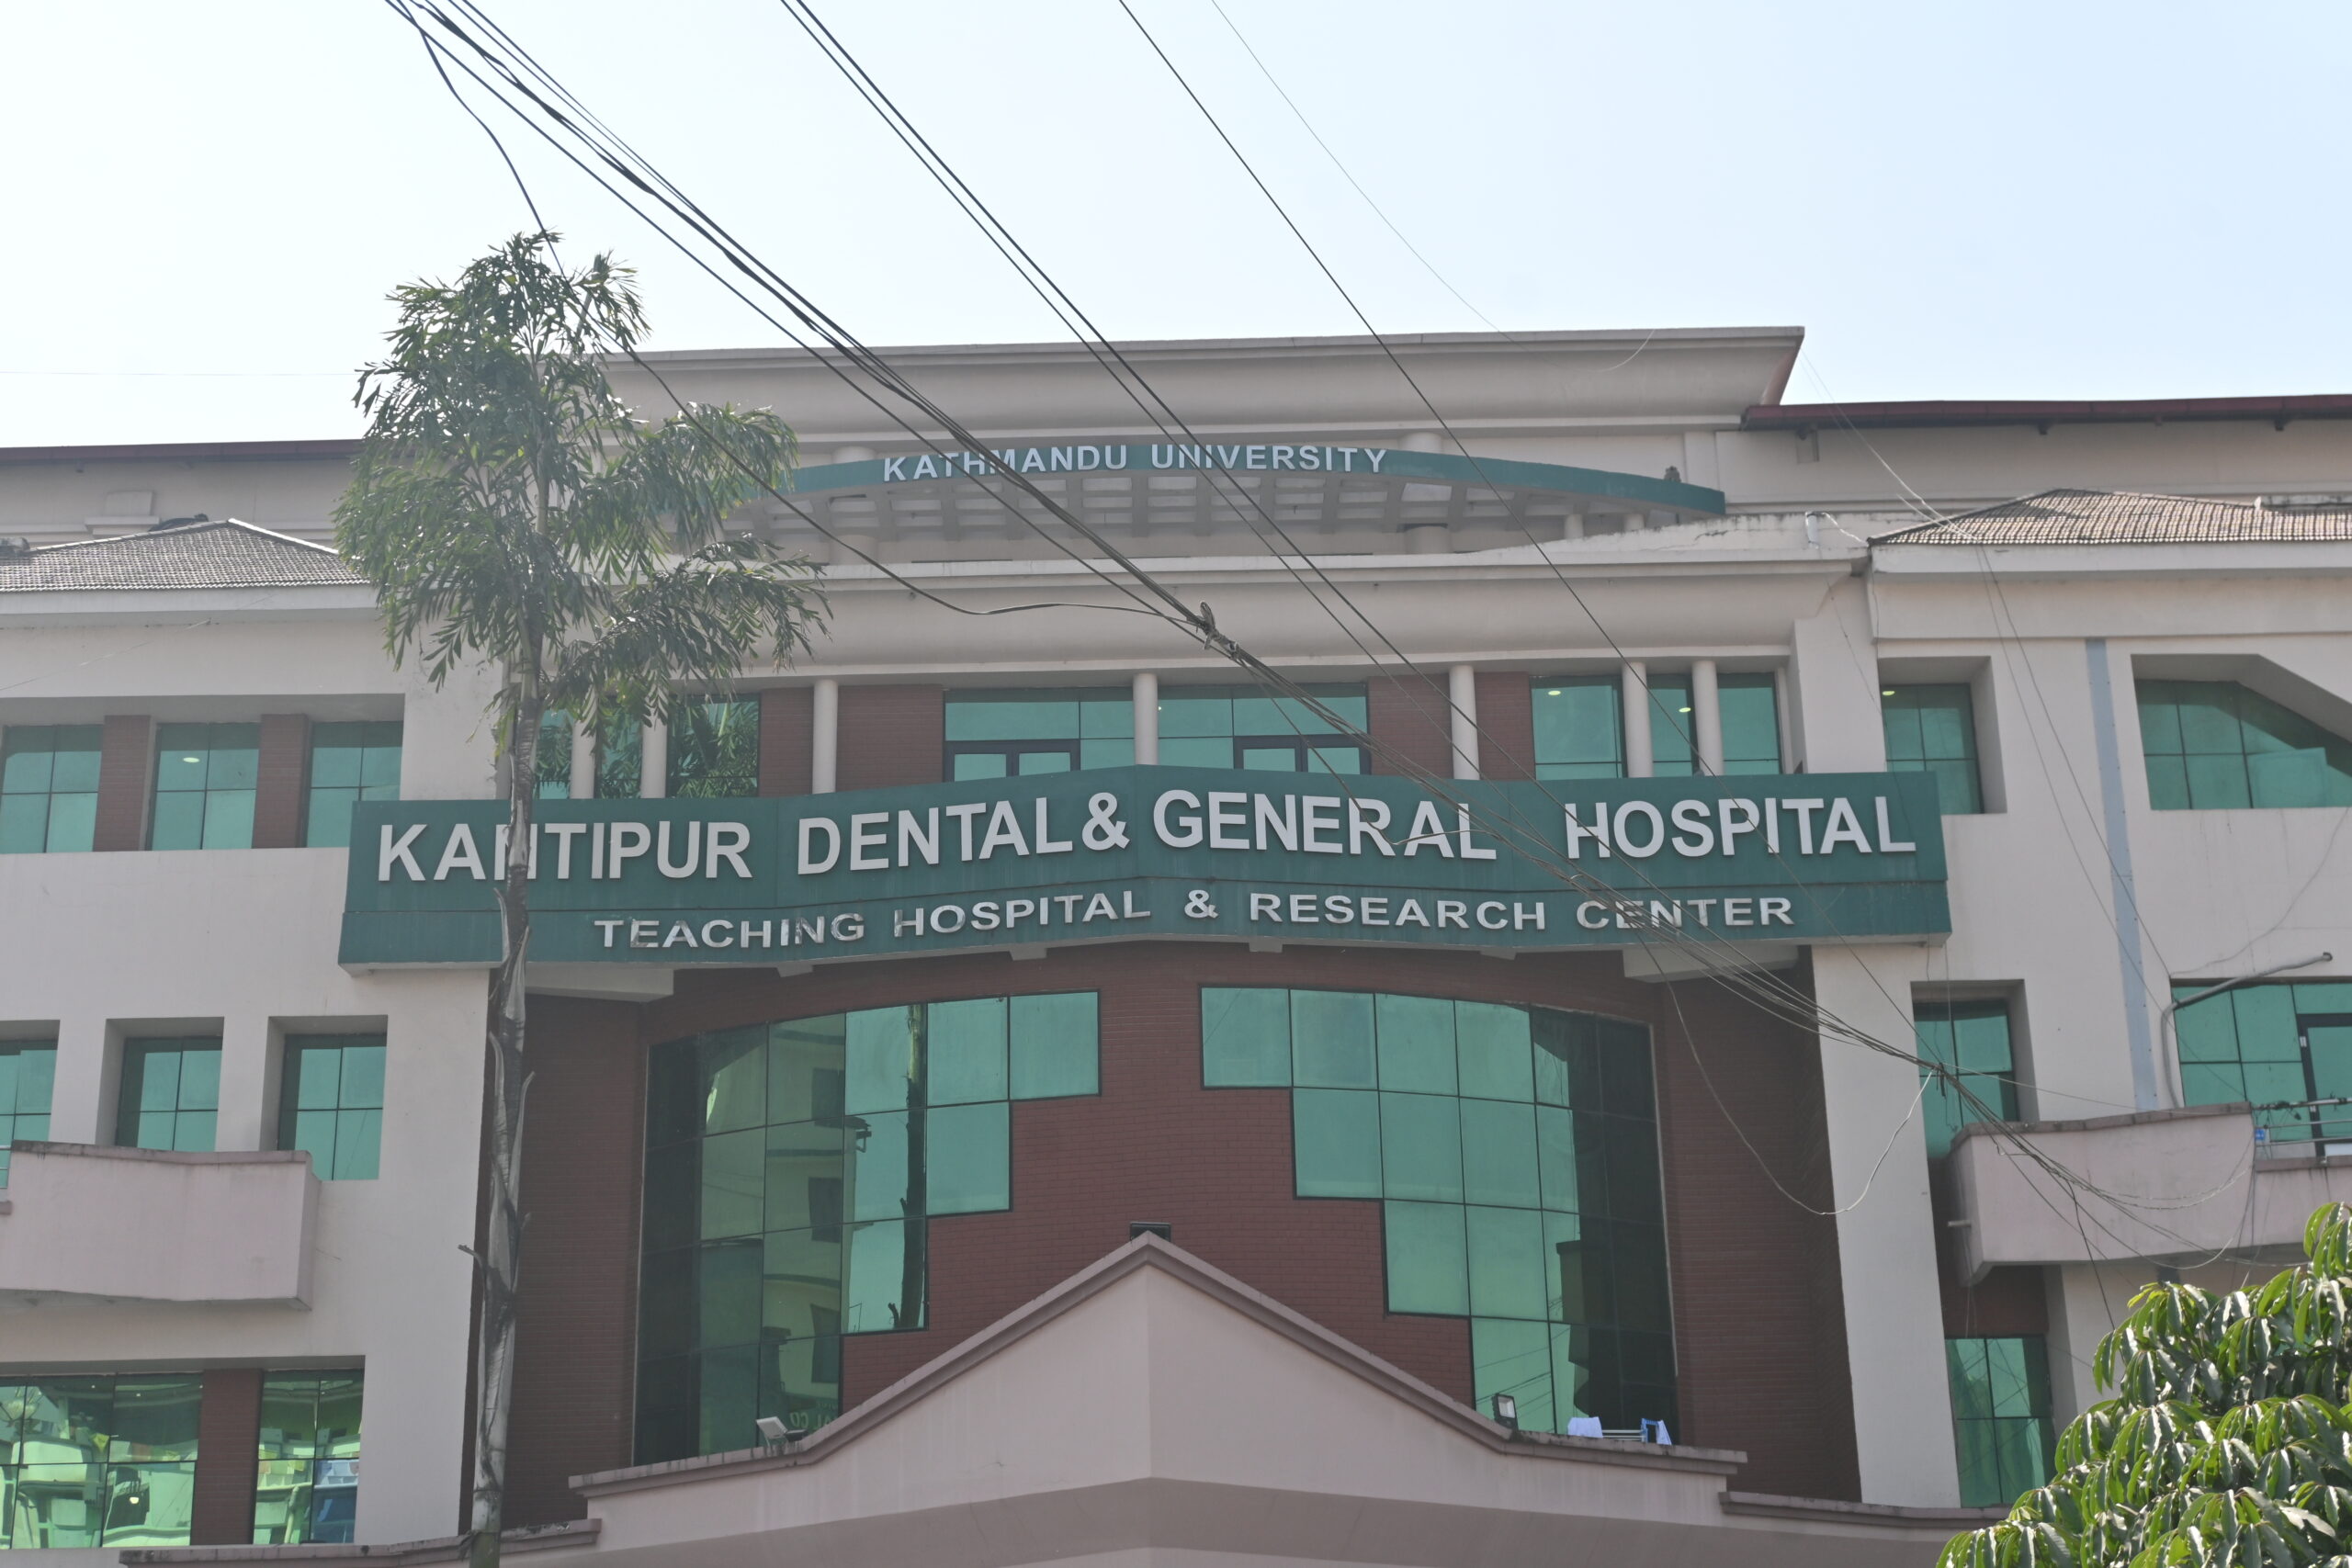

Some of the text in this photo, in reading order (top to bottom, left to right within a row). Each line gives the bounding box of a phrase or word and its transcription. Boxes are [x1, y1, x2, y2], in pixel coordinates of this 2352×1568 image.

[883, 445, 1387, 482] KATHMANDU UNIVERSITY
[797, 797, 1073, 875] DENTAL
[1081, 792, 1130, 851] &
[1153, 789, 1497, 861] GENERAL
[1565, 796, 1917, 860] HOSPITAL
[594, 889, 1794, 949] TEACHING HOSPITAL & RESEARCH CENTER
